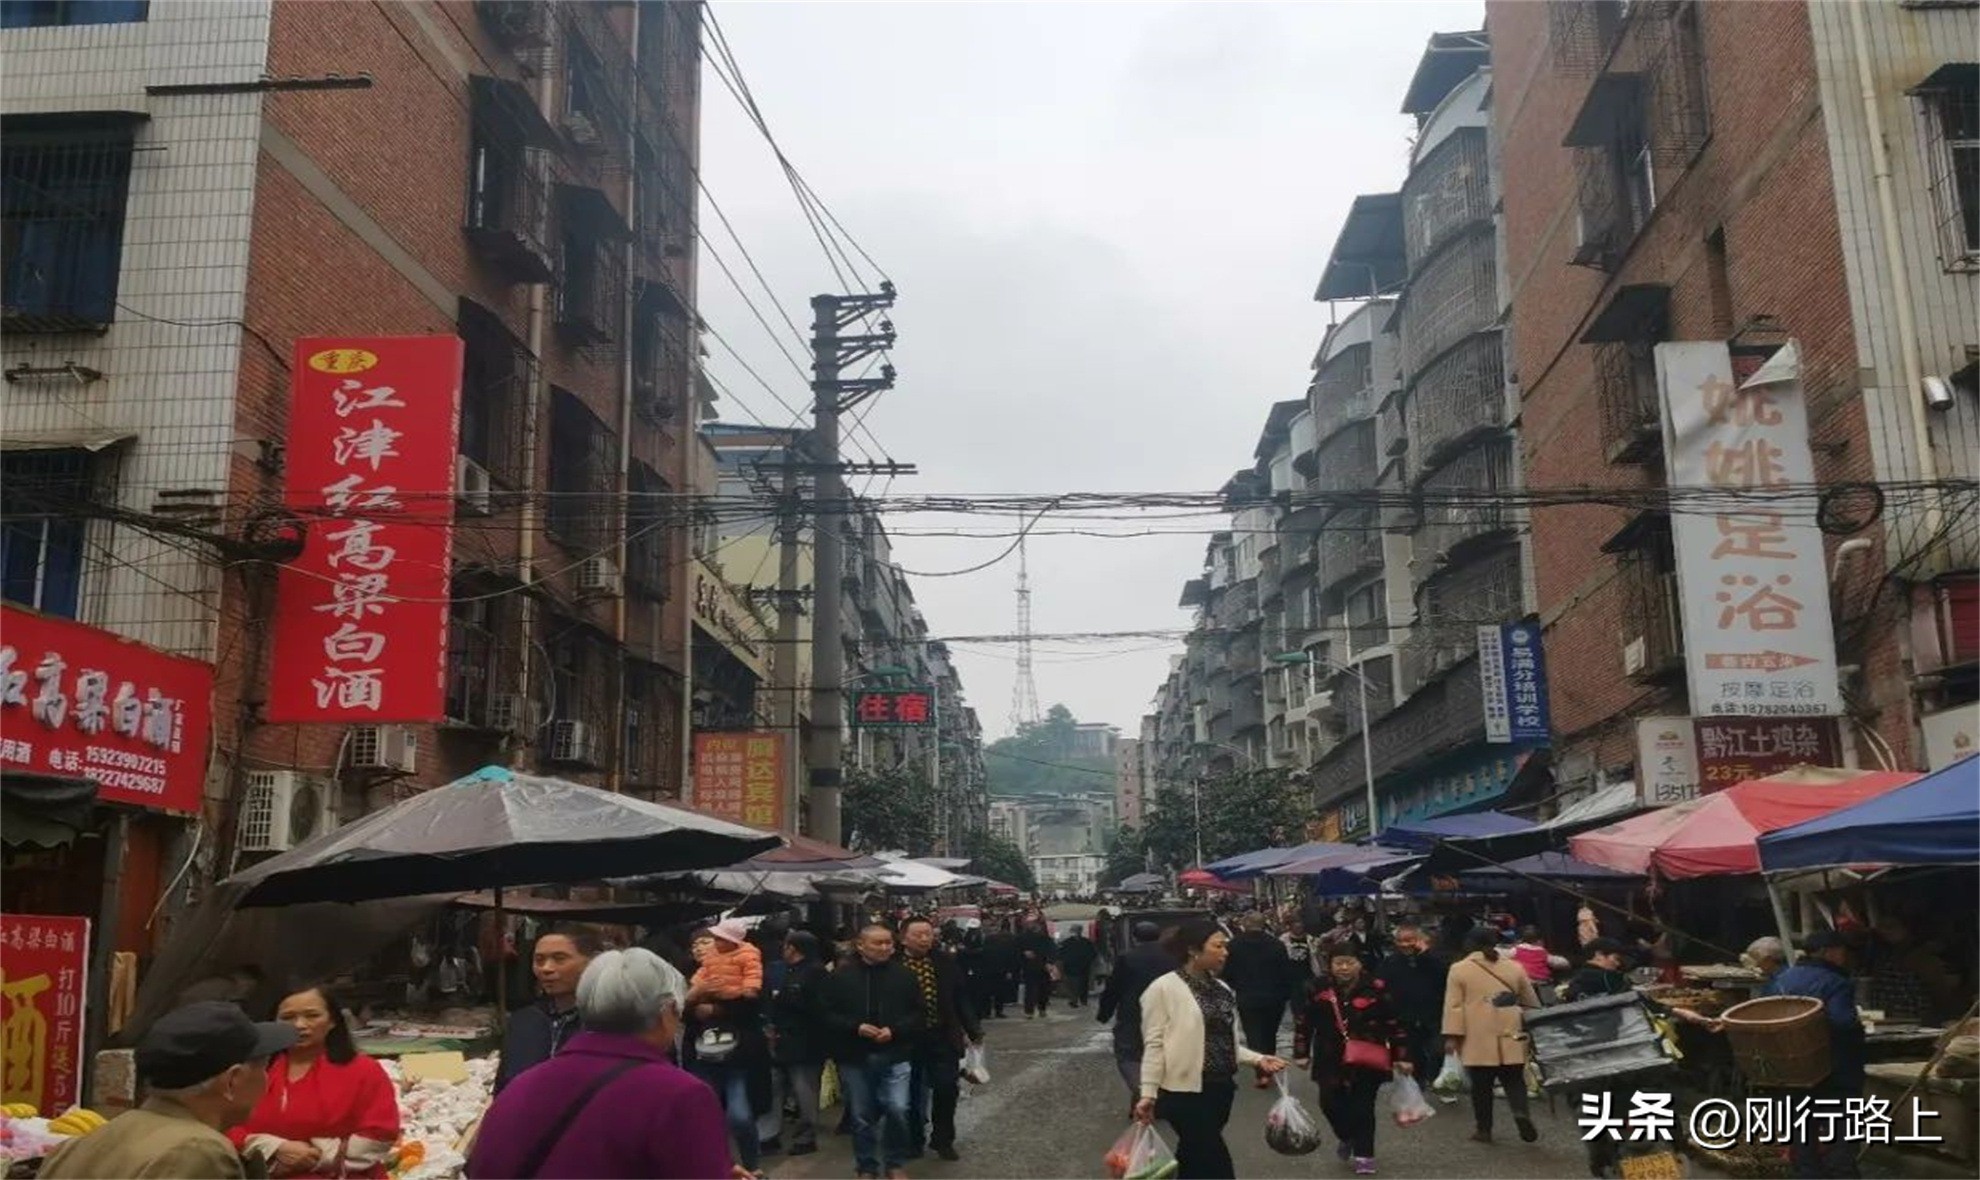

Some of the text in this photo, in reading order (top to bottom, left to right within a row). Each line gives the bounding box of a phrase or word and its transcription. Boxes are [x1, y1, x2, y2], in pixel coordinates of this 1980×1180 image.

[311, 378, 405, 712] 江津红高粱白酒
[1720, 680, 1817, 700] 按摩足浴
[857, 694, 929, 722] 住宿
[1701, 724, 1820, 758] 黔江土鸡杂
